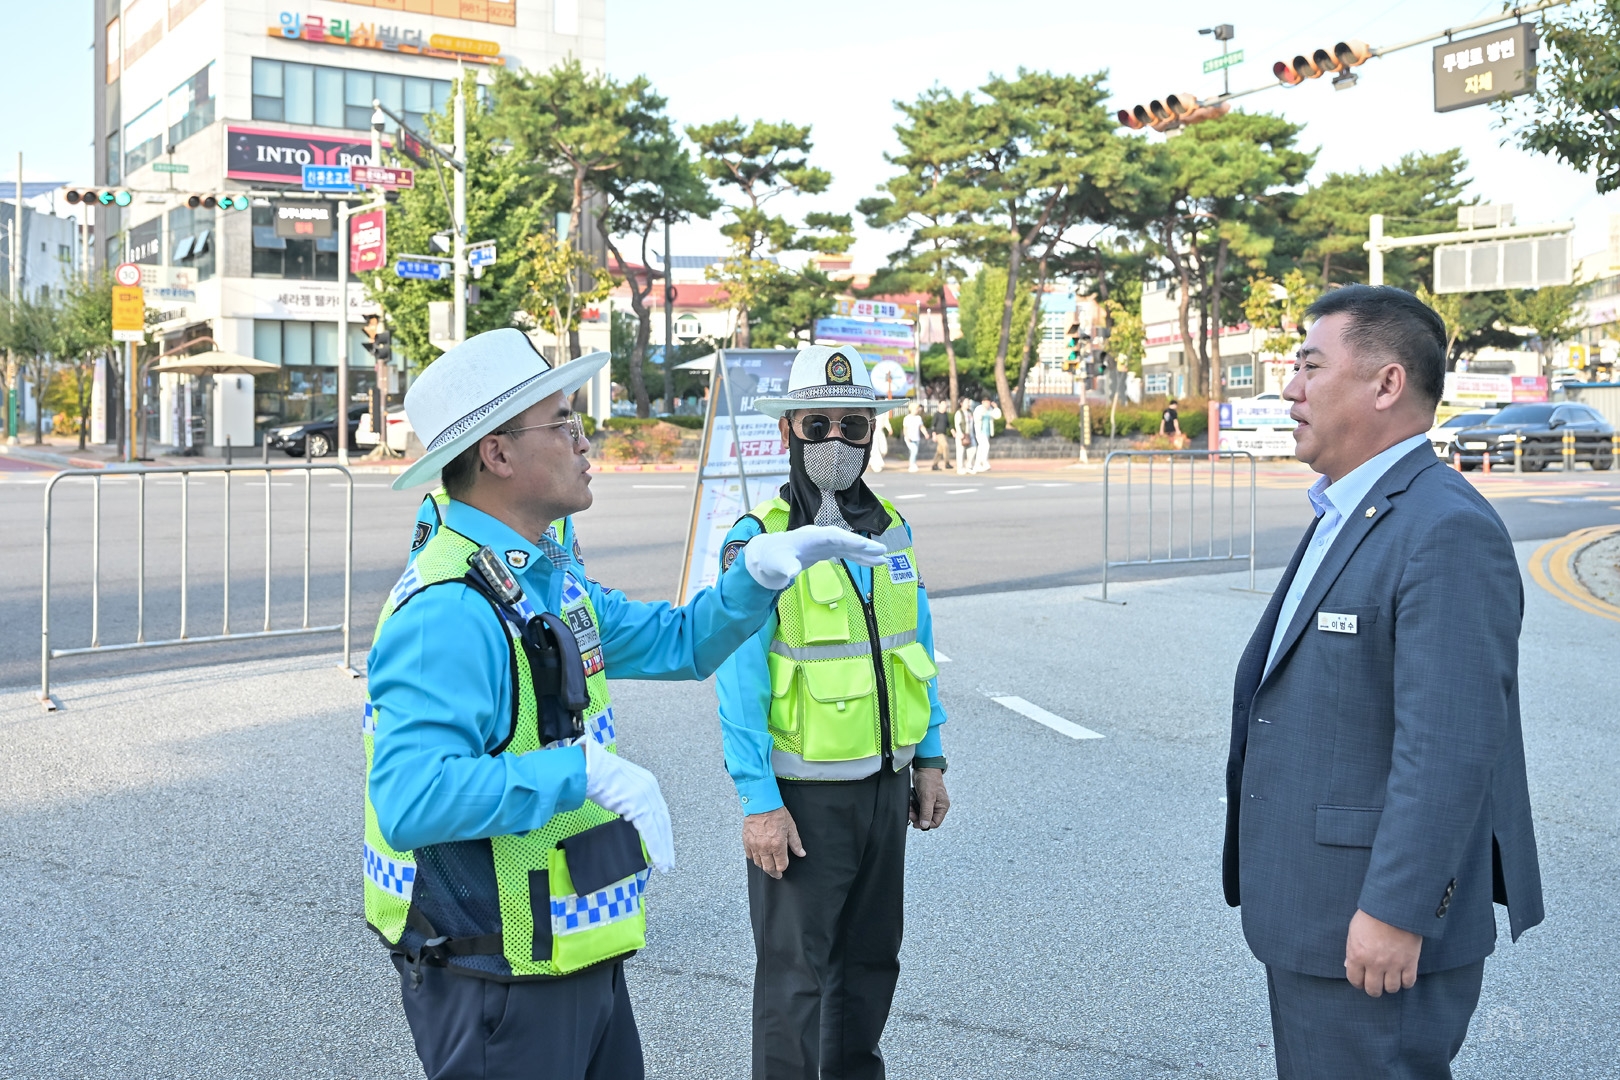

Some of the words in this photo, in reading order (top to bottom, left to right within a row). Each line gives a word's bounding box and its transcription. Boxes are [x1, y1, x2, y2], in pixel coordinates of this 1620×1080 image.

[256, 145, 311, 165] INTO
[122, 271, 135, 281] 30
[569, 609, 591, 632] 교통
